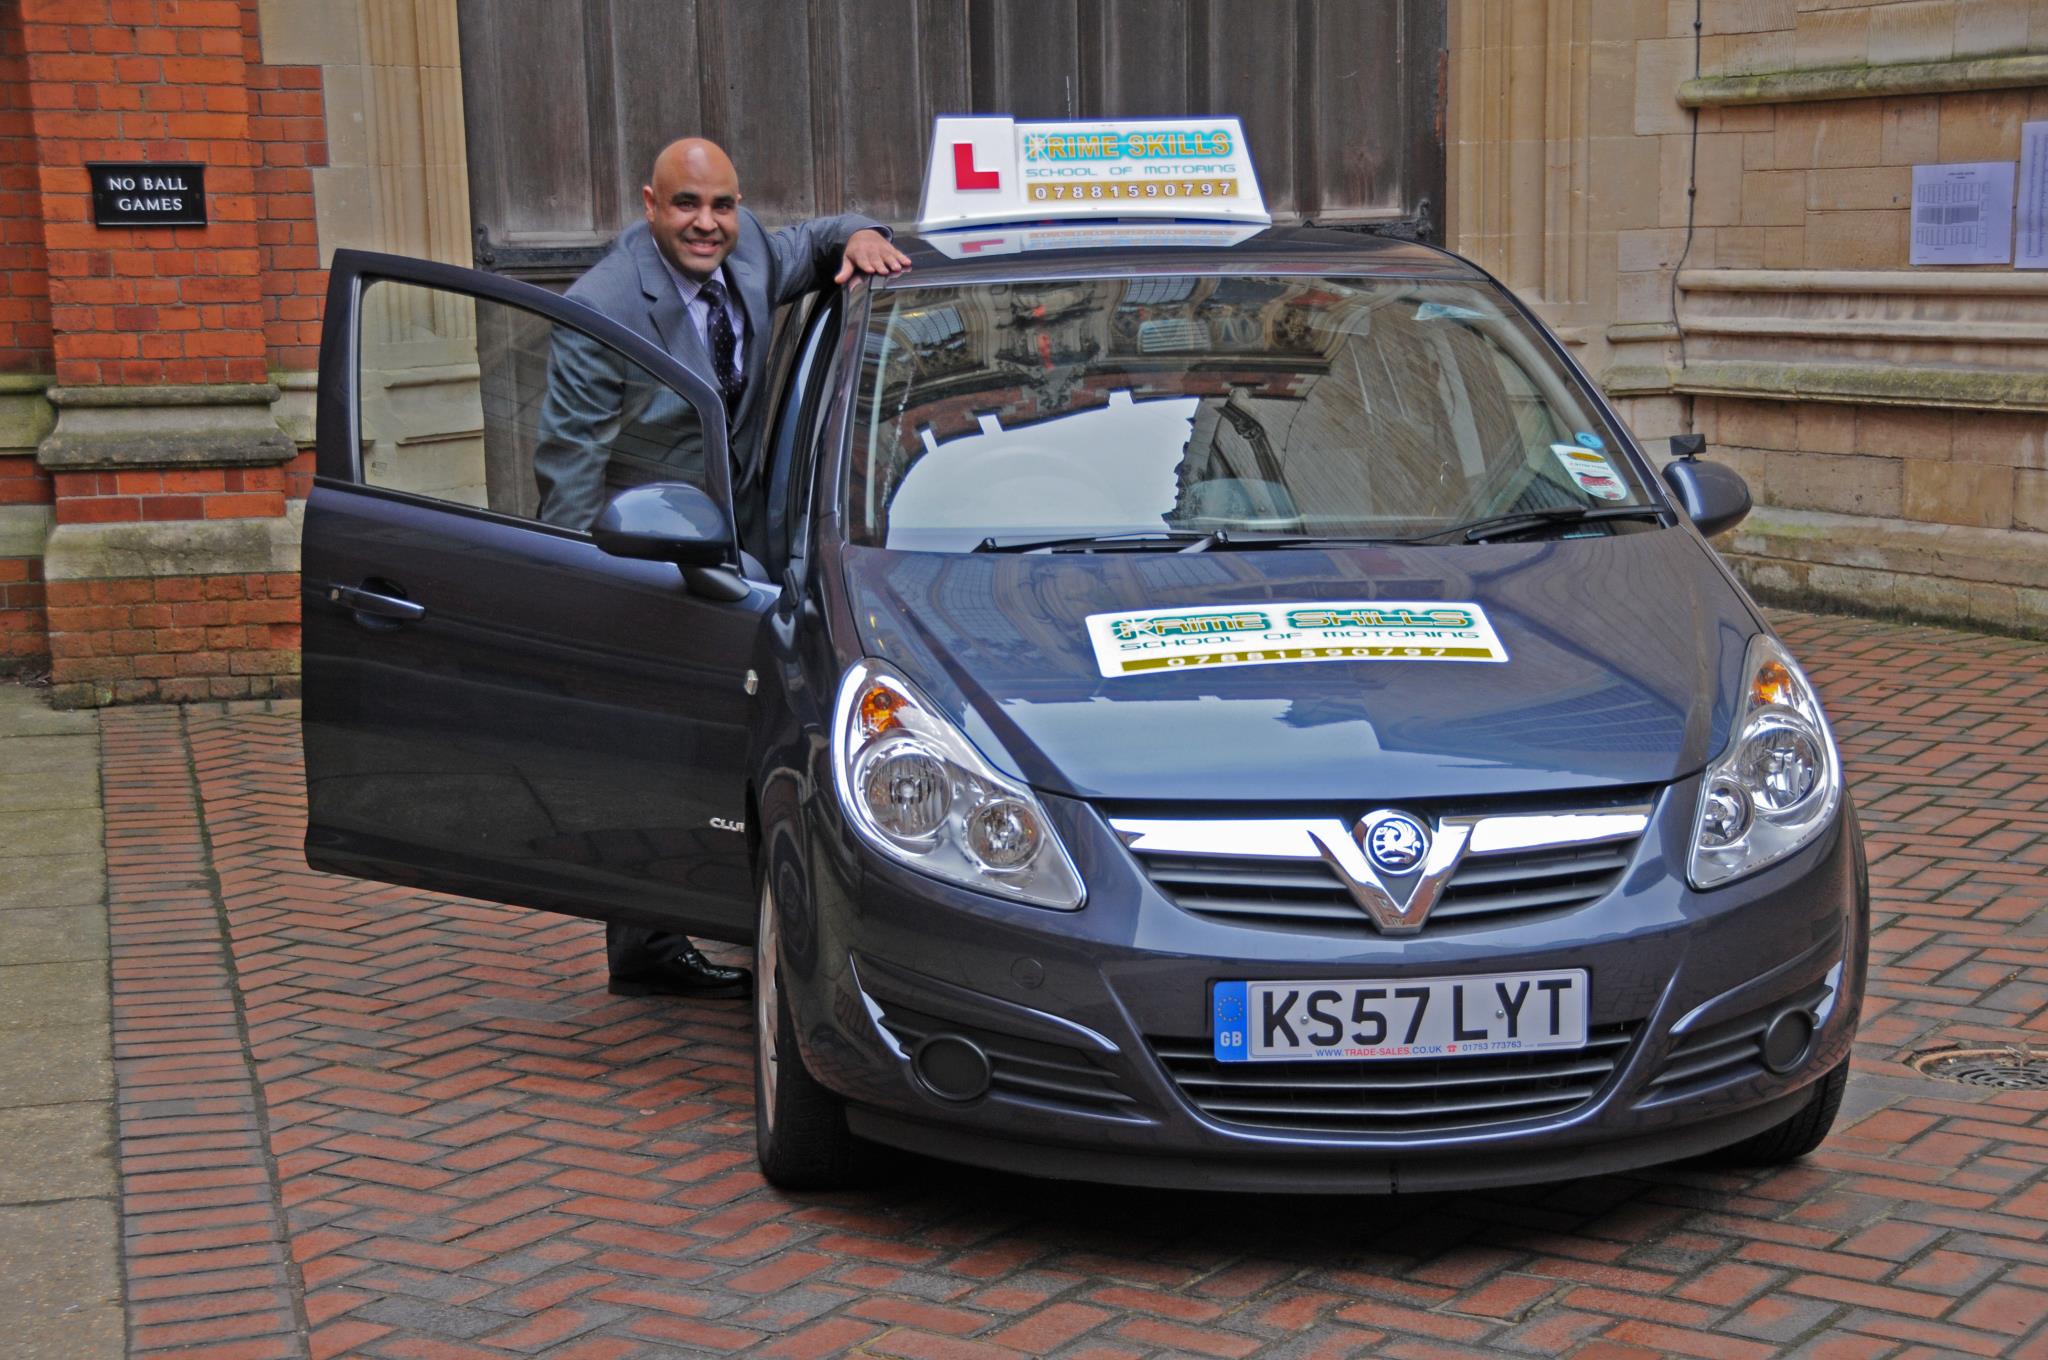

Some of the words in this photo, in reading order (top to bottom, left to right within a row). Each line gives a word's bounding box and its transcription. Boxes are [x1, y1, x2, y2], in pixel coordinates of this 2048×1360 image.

[1127, 132, 1231, 157] SKILLS
[953, 142, 1000, 191] L
[1025, 167, 1099, 177] SCHOOL
[1109, 166, 1133, 175] OF
[1144, 163, 1236, 175] MOTORING
[109, 178, 136, 191] NO
[143, 178, 188, 191] BALL
[119, 198, 183, 211] GAMES
[1292, 610, 1469, 628] SKILLS
[1120, 635, 1244, 650] SCHOOL
[1263, 632, 1303, 640] OF
[1323, 630, 1480, 639] MOTORING
[1262, 986, 1431, 1048] KS57
[1453, 978, 1572, 1042] LYT
[1219, 1031, 1243, 1047] GB
